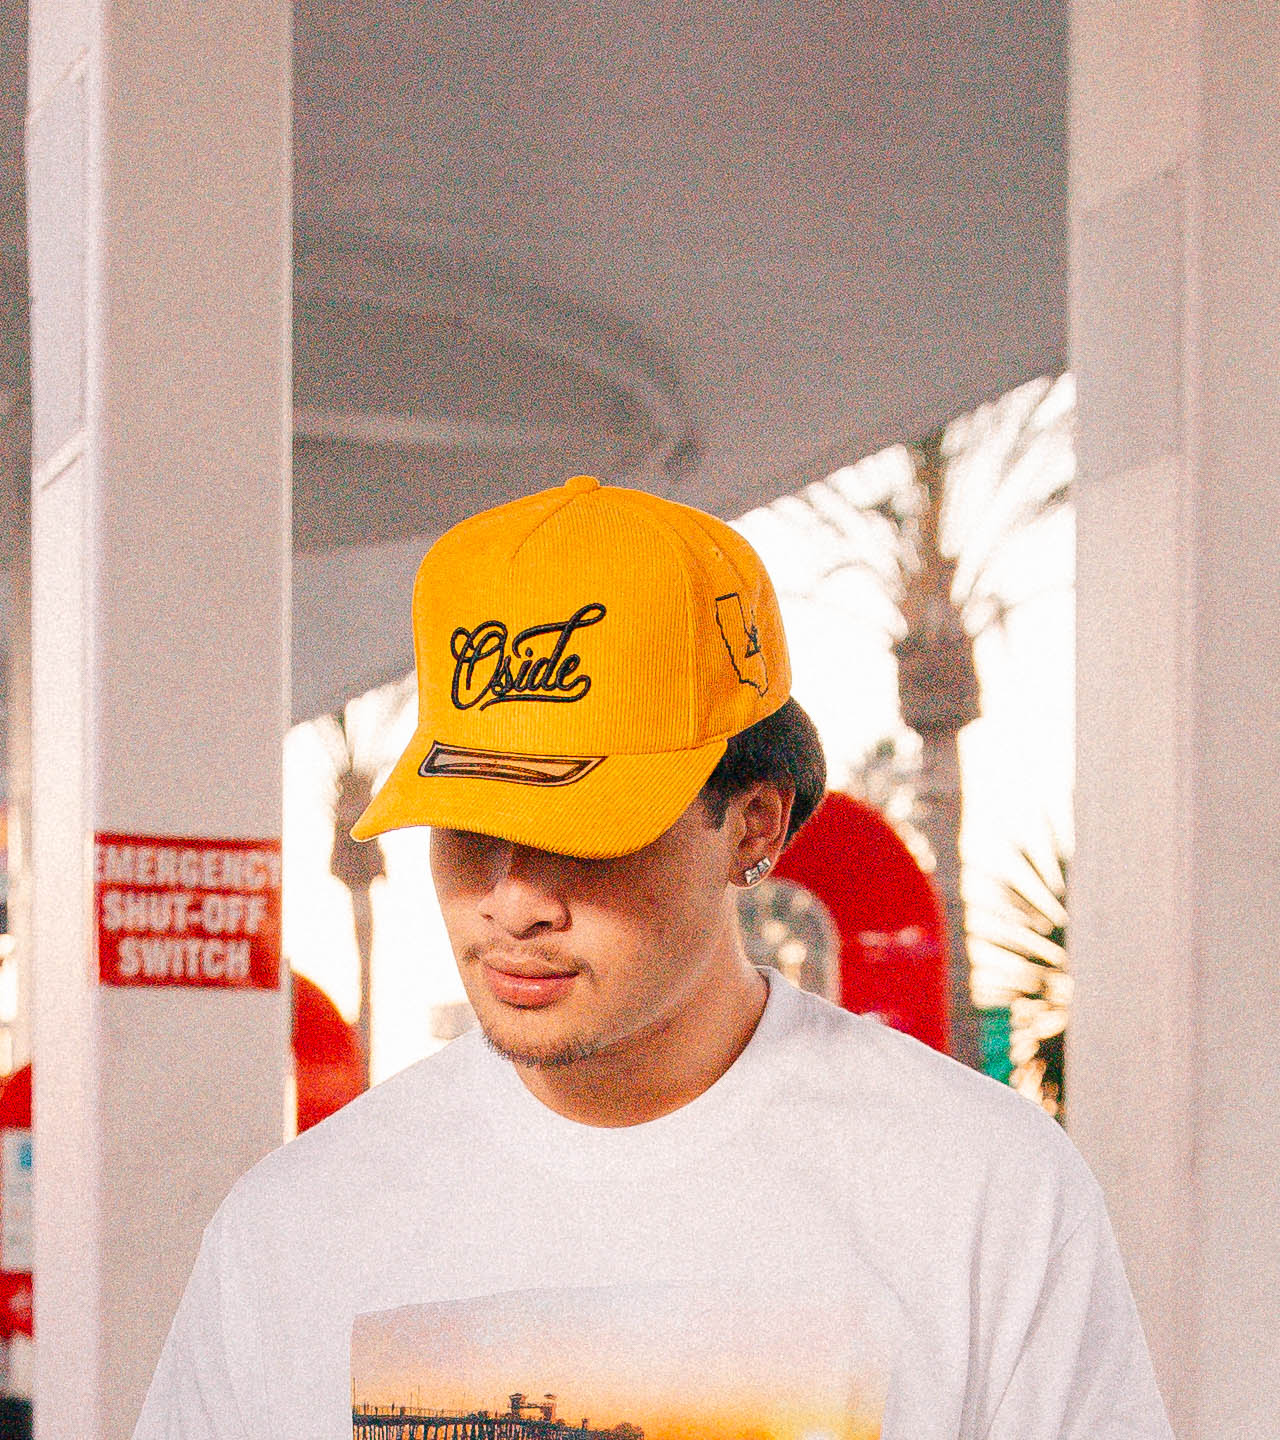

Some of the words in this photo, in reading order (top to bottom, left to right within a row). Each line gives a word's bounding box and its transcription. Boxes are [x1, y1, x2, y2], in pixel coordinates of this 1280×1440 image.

[450, 602, 607, 712] Oside
[103, 891, 267, 935] SHUT-OFF
[118, 937, 250, 978] SWITCH
